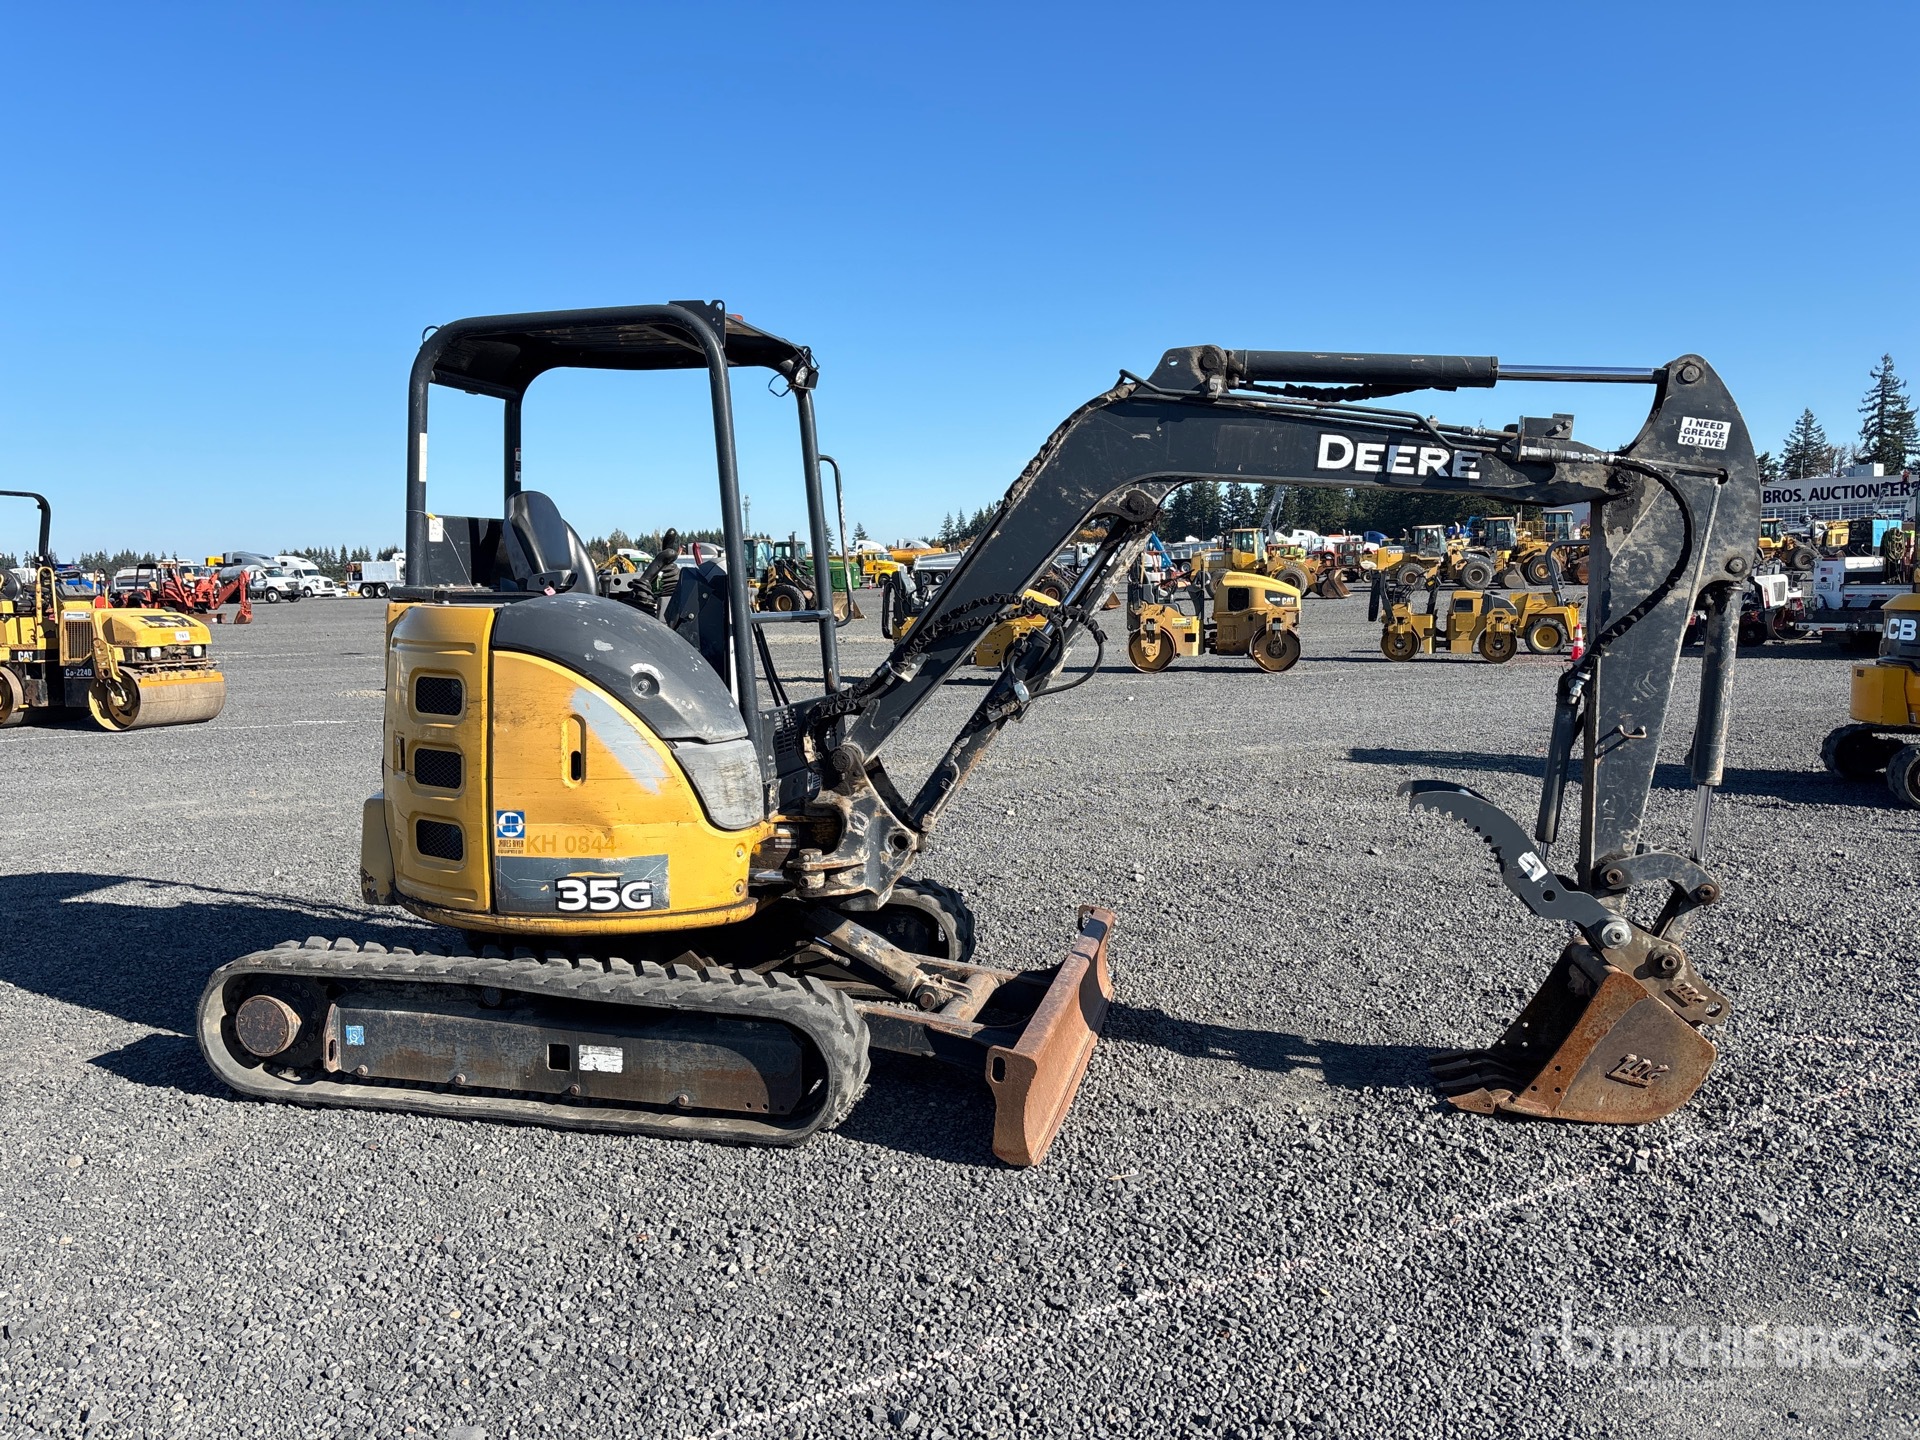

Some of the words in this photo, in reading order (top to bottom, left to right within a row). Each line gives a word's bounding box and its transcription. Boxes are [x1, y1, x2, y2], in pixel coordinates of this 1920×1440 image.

[1695, 420, 1724, 430] NEED
[1683, 427, 1725, 439] GREASE
[1681, 435, 1695, 444] TO
[1697, 438, 1725, 448] LIVE!
[1317, 433, 1482, 480] DEERE
[1763, 488, 1805, 503] BROS.
[1282, 597, 1295, 605] CAT
[1883, 618, 1917, 640] CB
[18, 651, 33, 662] CAT
[526, 835, 557, 853] KH
[564, 835, 617, 853] 0844
[555, 877, 653, 912] 35G
